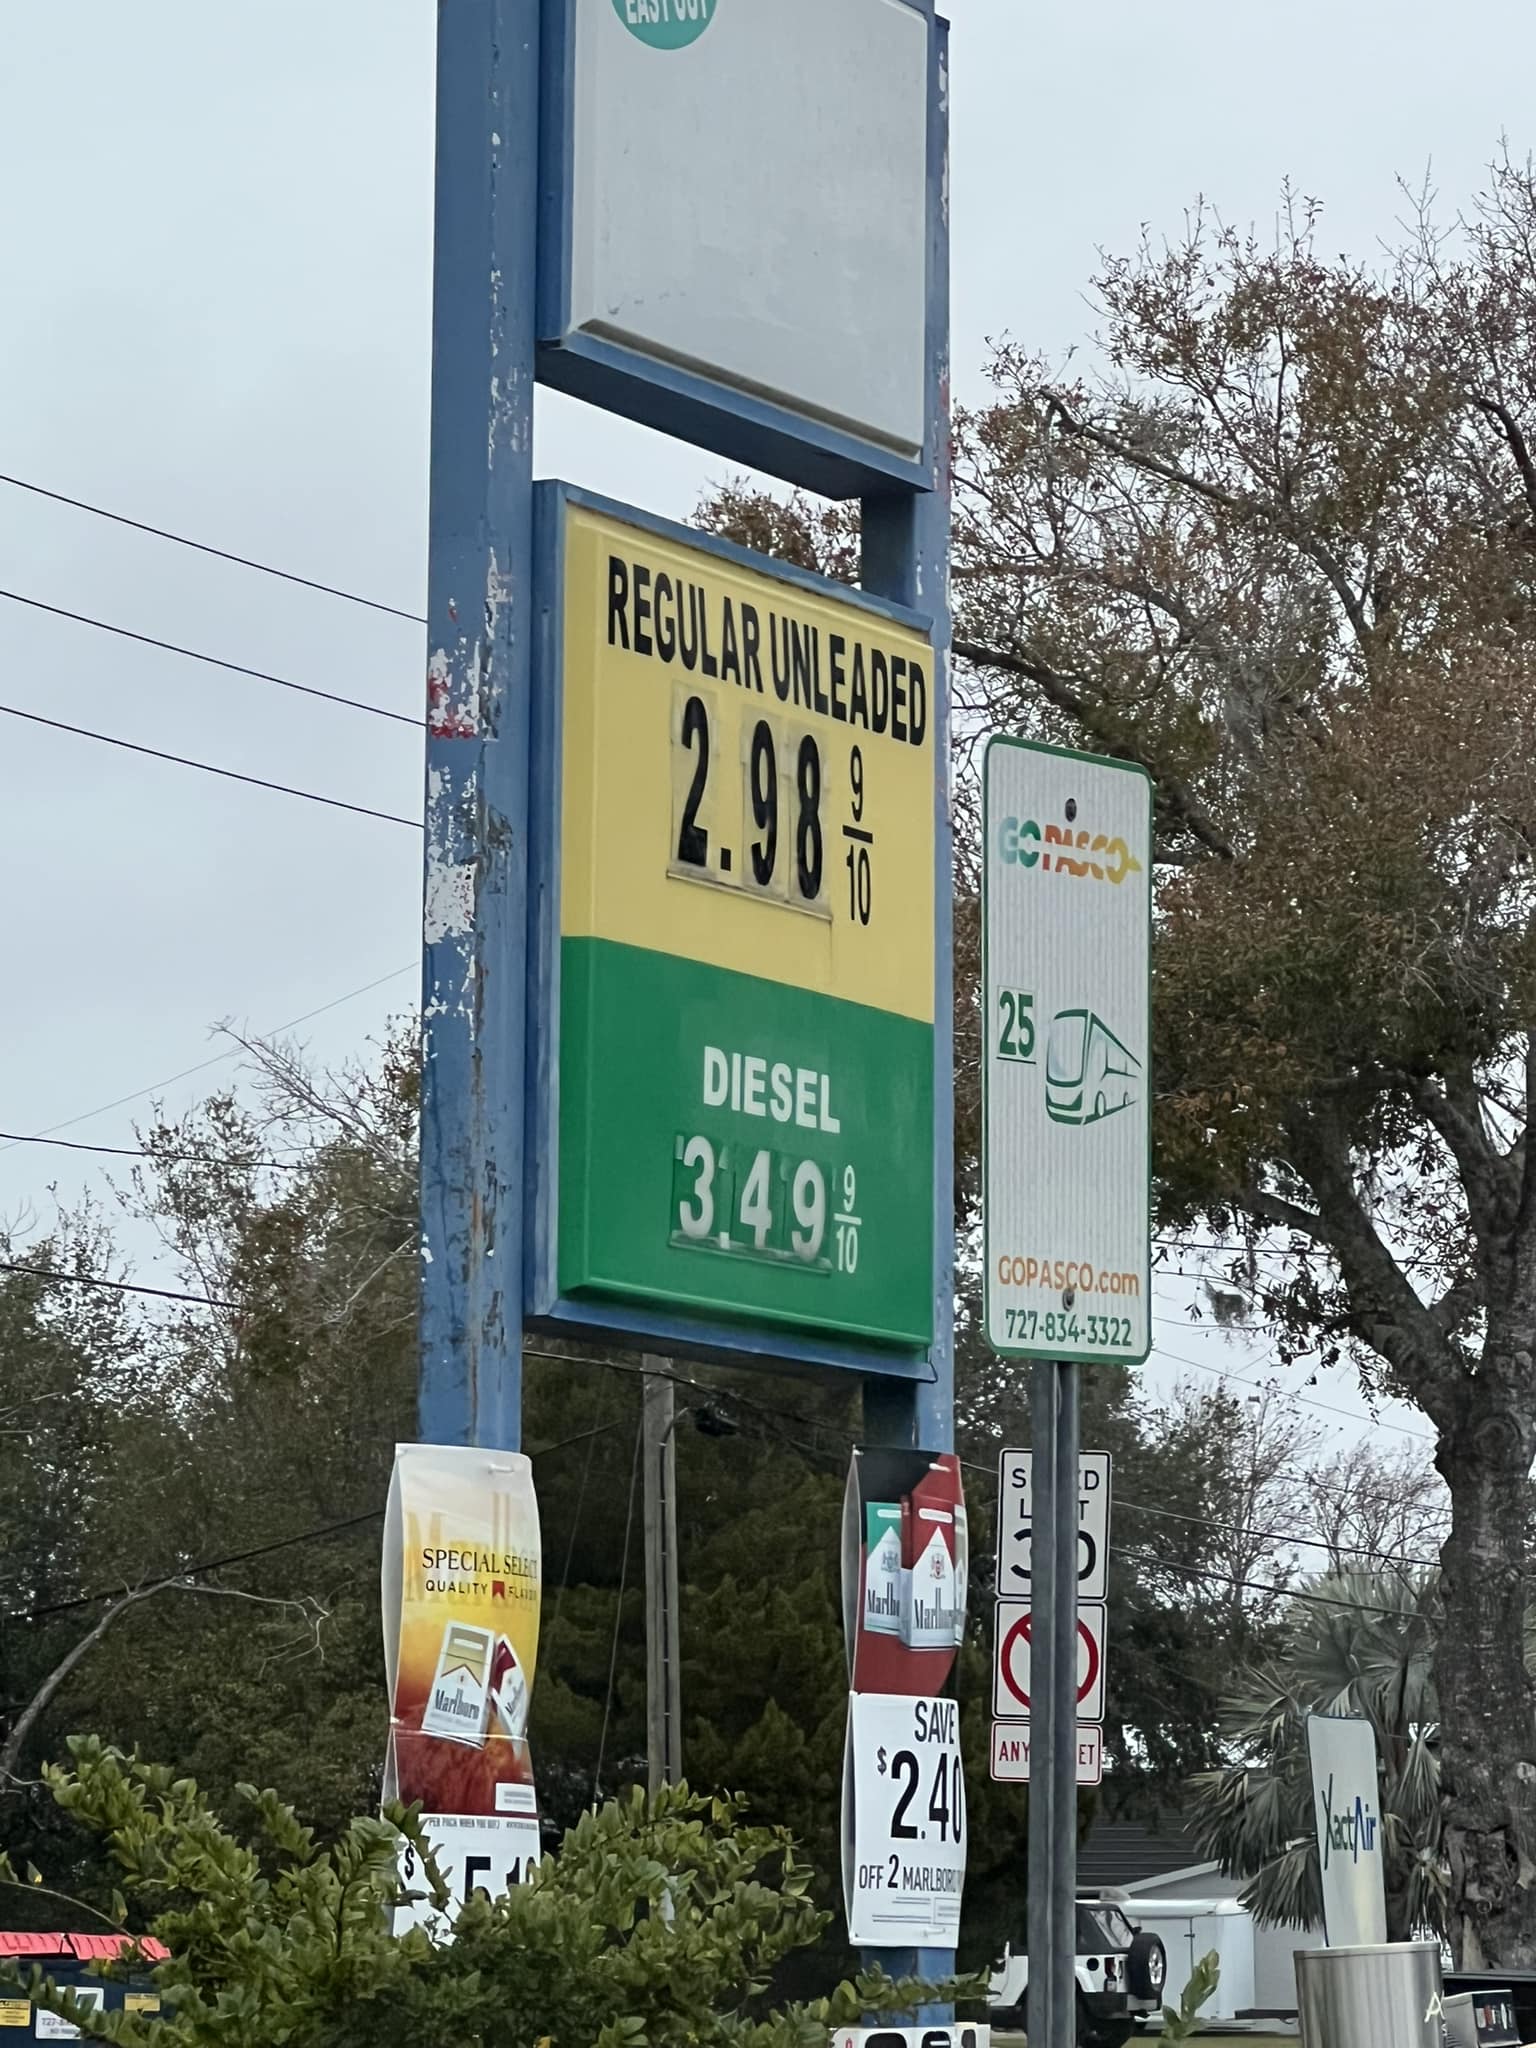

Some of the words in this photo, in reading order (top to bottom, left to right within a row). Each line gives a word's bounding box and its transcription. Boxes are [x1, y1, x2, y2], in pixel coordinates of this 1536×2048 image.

[608, 555, 763, 693] REGULAR
[769, 612, 926, 746] UNLEADED
[678, 696, 823, 900] 2.98
[999, 990, 1035, 1058] 25
[703, 1046, 840, 1134] DIESEL
[679, 1135, 826, 1262] 3.49
[998, 1255, 1140, 1297] GOPASCO.com
[1005, 1309, 1132, 1347] 727-834-3322
[422, 1548, 500, 1574] SPECIAL
[425, 1579, 488, 1595] QUALITY
[435, 1687, 480, 1720] Marlboro
[914, 1700, 955, 1745] SAVE
[999, 1740, 1030, 1763] ANY
[859, 1864, 884, 1889] OFF
[887, 1853, 900, 1889] 2
